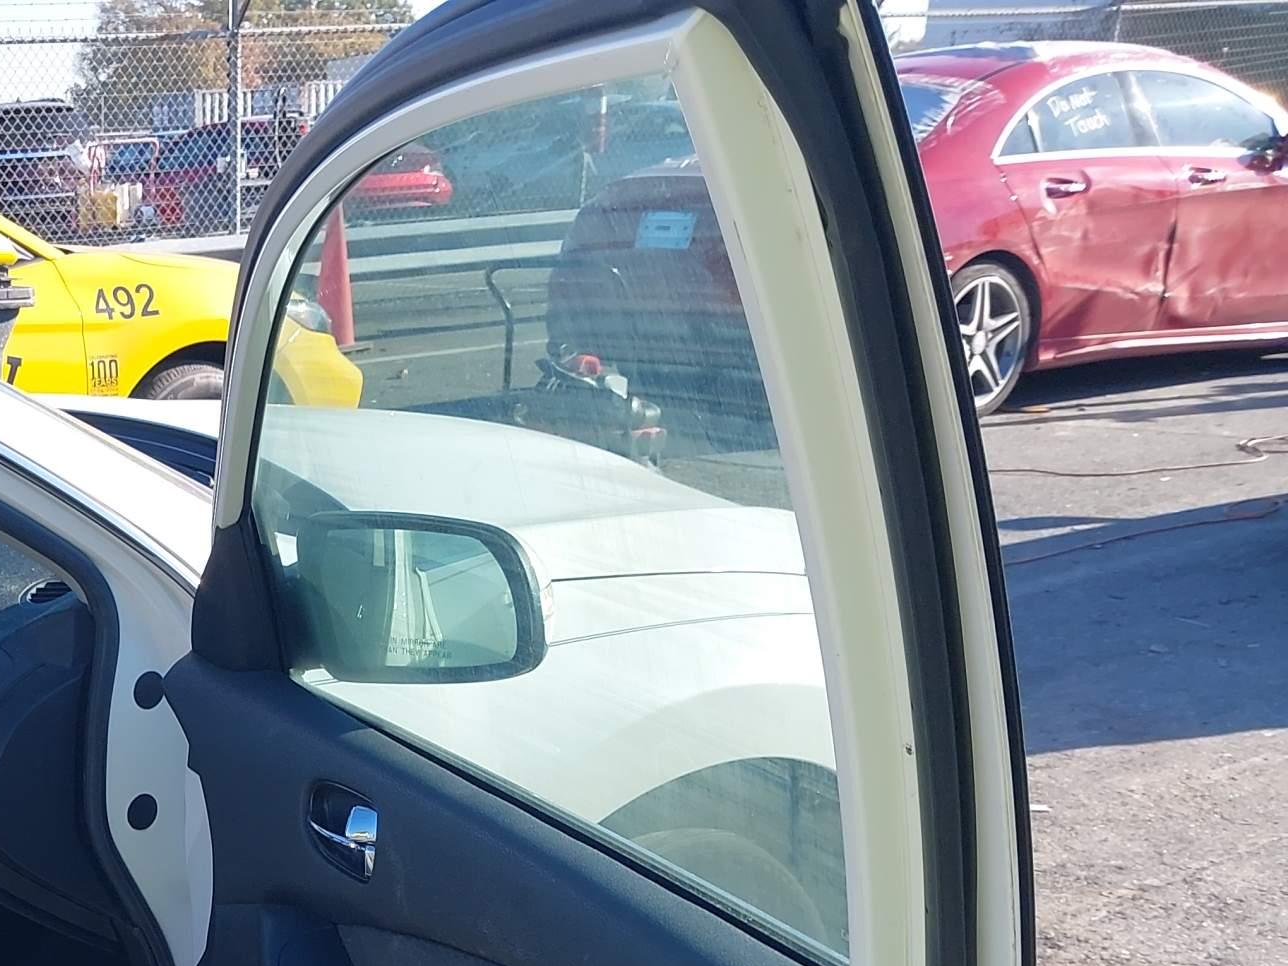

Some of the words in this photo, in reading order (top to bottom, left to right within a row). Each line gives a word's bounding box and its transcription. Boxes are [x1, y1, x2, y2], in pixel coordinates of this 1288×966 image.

[1046, 95, 1070, 118] Do
[95, 283, 160, 320] 492
[89, 359, 119, 381] 100
